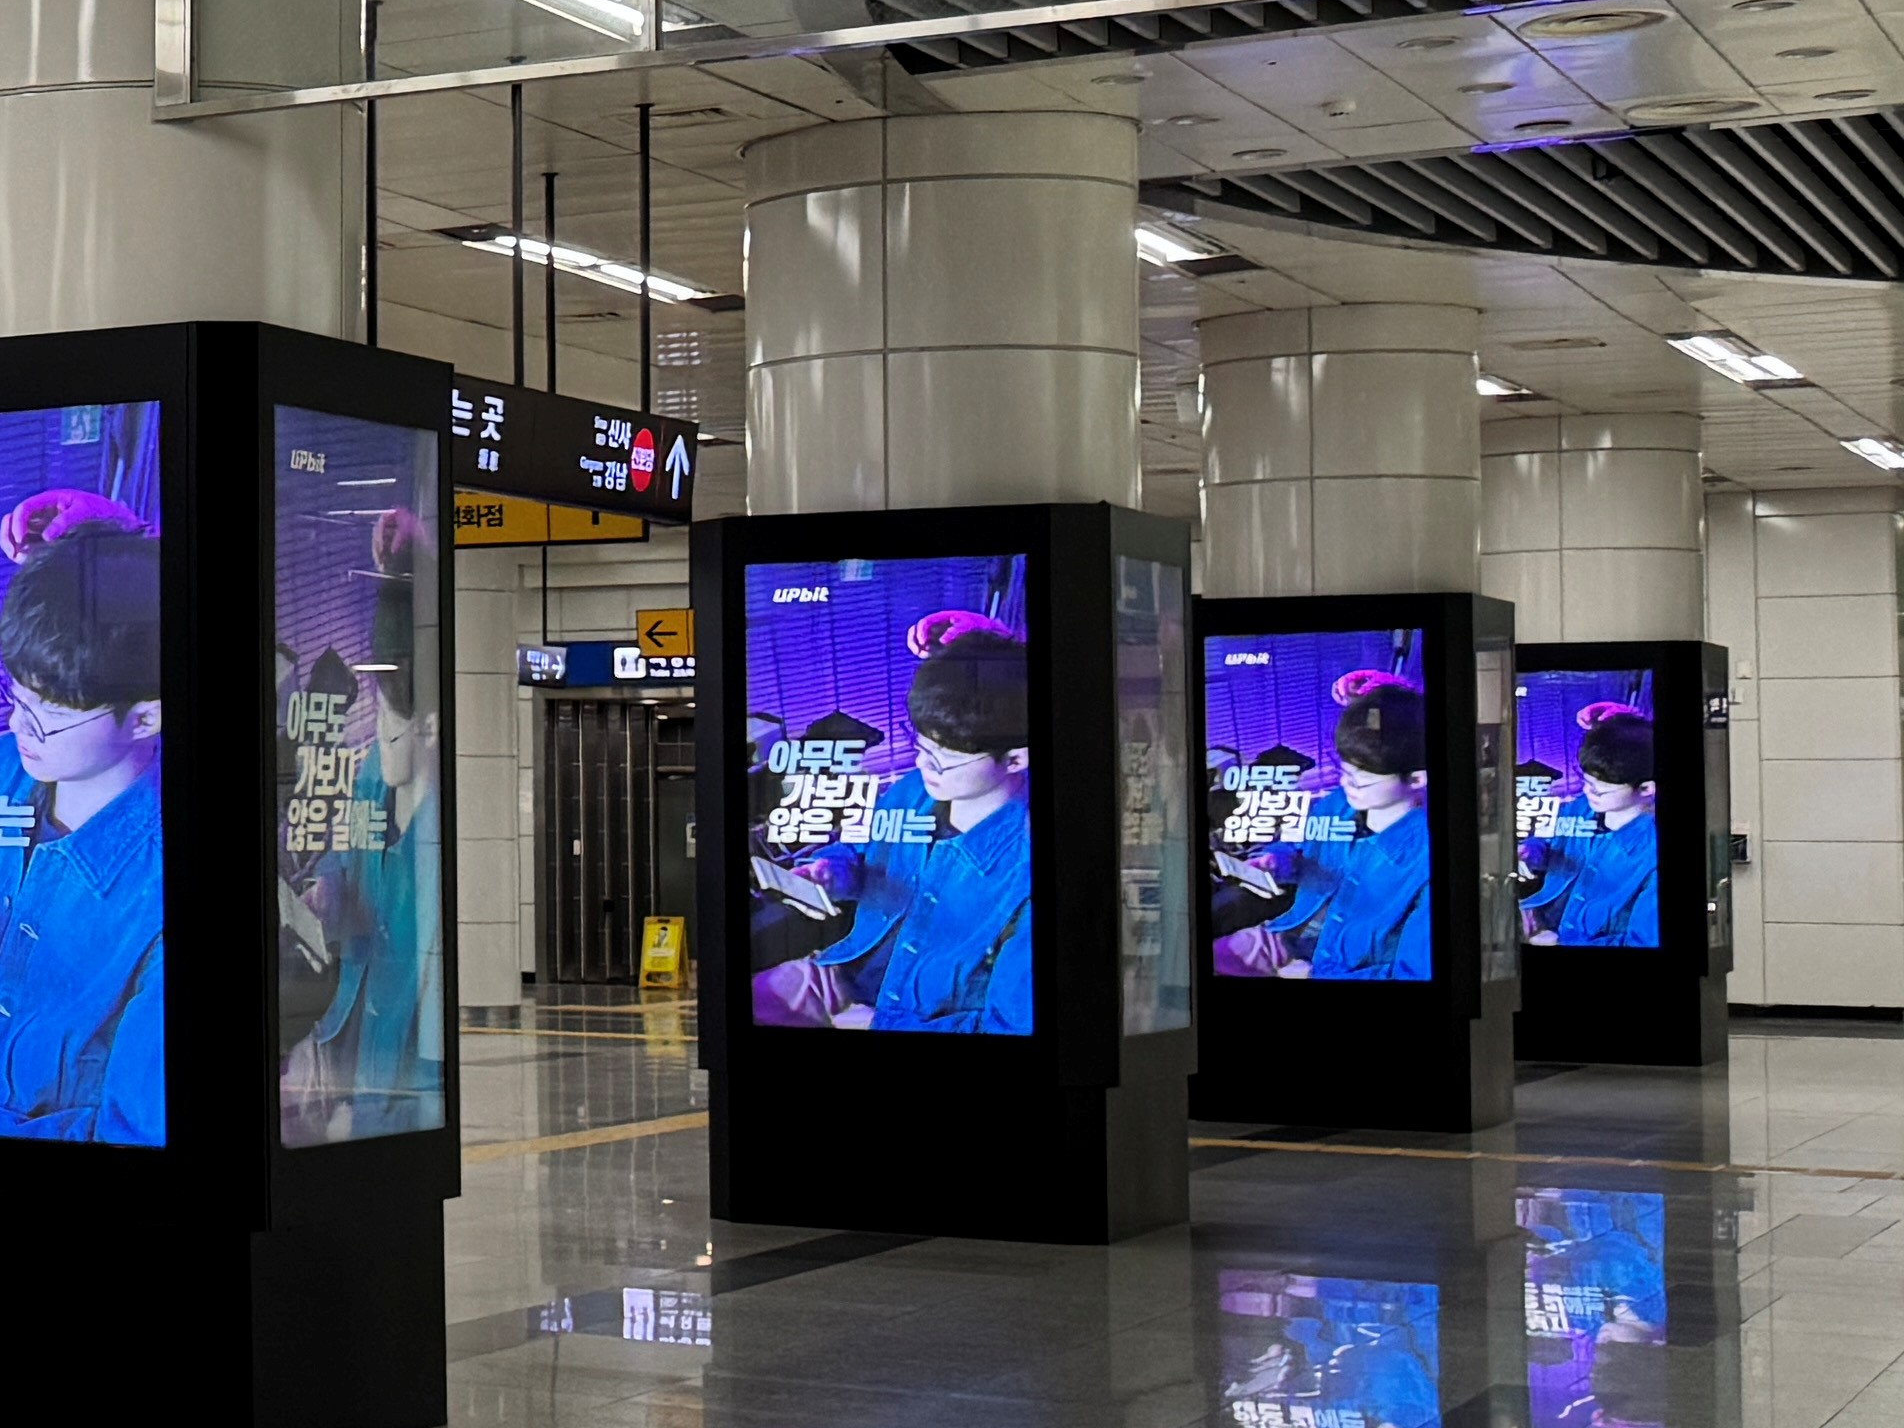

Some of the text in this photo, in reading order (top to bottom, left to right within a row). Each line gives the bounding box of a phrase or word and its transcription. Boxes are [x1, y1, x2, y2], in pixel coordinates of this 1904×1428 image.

[481, 396, 504, 441] 곳
[608, 419, 632, 450] 신사
[604, 461, 628, 491] 강남
[286, 691, 347, 745] 아무도
[293, 745, 356, 798] 가보지
[768, 740, 866, 774] 아무도
[780, 774, 879, 809] 가보지
[1223, 765, 1301, 791] 아무도
[1232, 790, 1311, 817] 가보지
[286, 799, 387, 852] 않은 길에는
[767, 808, 936, 843] 않은 길에는
[1280, 815, 1356, 842] 길에는
